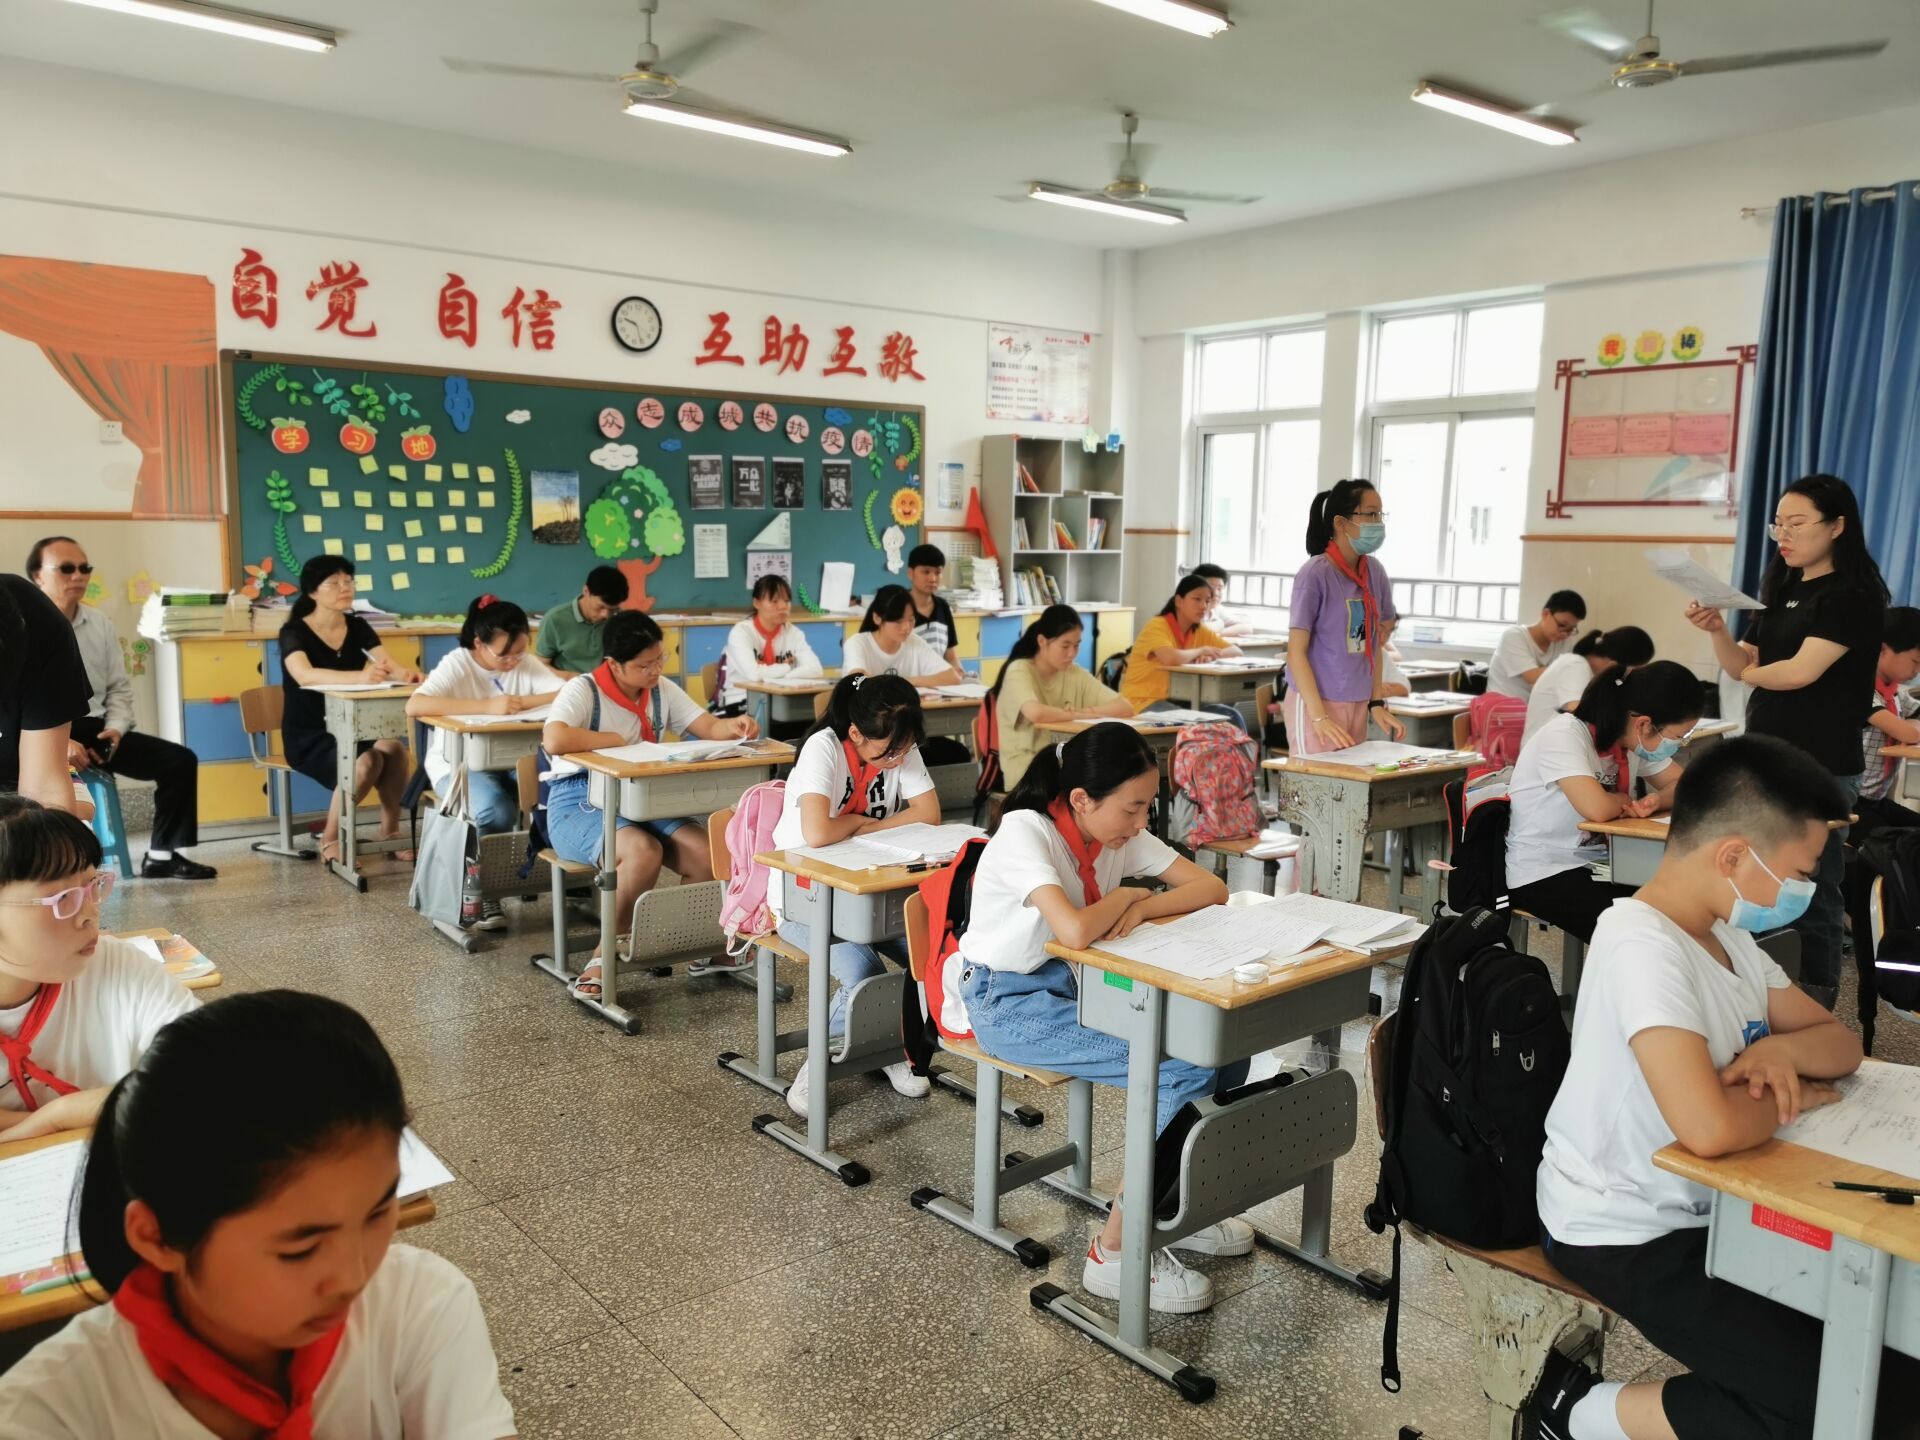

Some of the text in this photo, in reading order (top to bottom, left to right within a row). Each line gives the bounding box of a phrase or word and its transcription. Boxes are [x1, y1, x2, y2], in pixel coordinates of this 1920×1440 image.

[231, 248, 926, 383] 自觉 自信 互助互敬
[281, 429, 430, 457] 学习地
[601, 402, 872, 453] 众志成城共抗疫情
